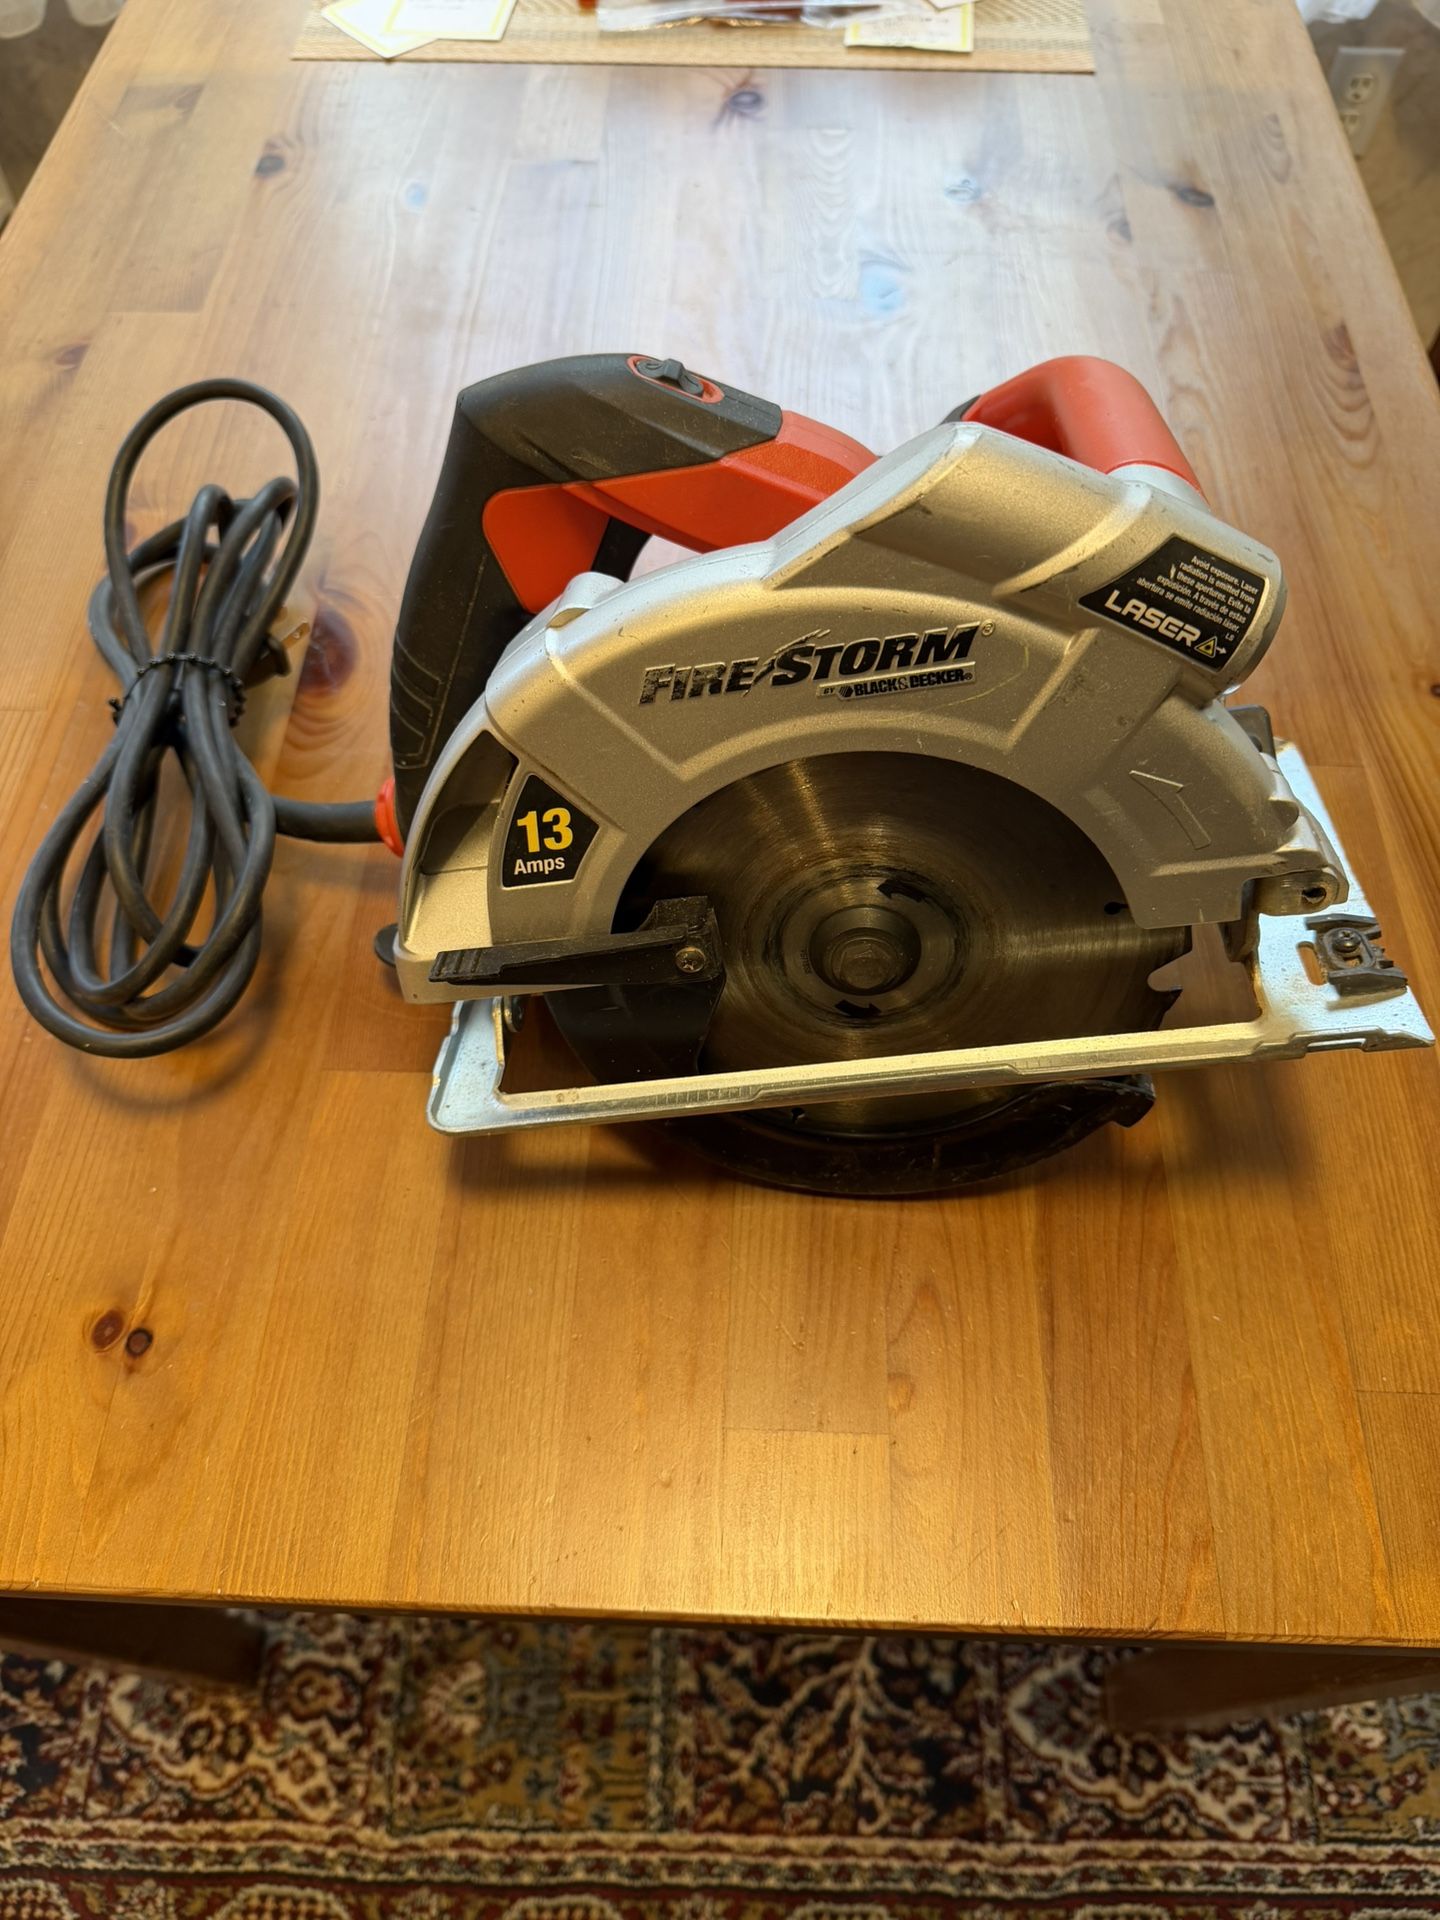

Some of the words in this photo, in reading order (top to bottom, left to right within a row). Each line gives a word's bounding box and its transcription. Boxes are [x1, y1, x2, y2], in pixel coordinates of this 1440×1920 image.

[1177, 571, 1196, 586] these
[1195, 582, 1227, 603] apertures.
[1227, 597, 1244, 611] Evite
[1244, 604, 1252, 614] la
[1180, 562, 1208, 581] radiation
[1208, 575, 1216, 585] is
[1215, 580, 1240, 597] emitted
[1240, 591, 1255, 605] from
[1191, 555, 1210, 570] Avoid
[1210, 566, 1240, 587] exposure.
[1241, 580, 1259, 595] Laser
[1104, 589, 1201, 648] LASER
[1136, 577, 1165, 596] abertura
[1164, 591, 1175, 601] se
[1174, 596, 1194, 610] emite
[1193, 605, 1223, 625] radiación
[1156, 575, 1192, 598] exposición.
[1192, 591, 1200, 601] A
[1199, 594, 1220, 611] través
[1219, 606, 1229, 615] de
[1228, 611, 1247, 624] estas
[823, 687, 835, 695] BY
[516, 807, 574, 853] 13
[513, 856, 566, 876] Amps
